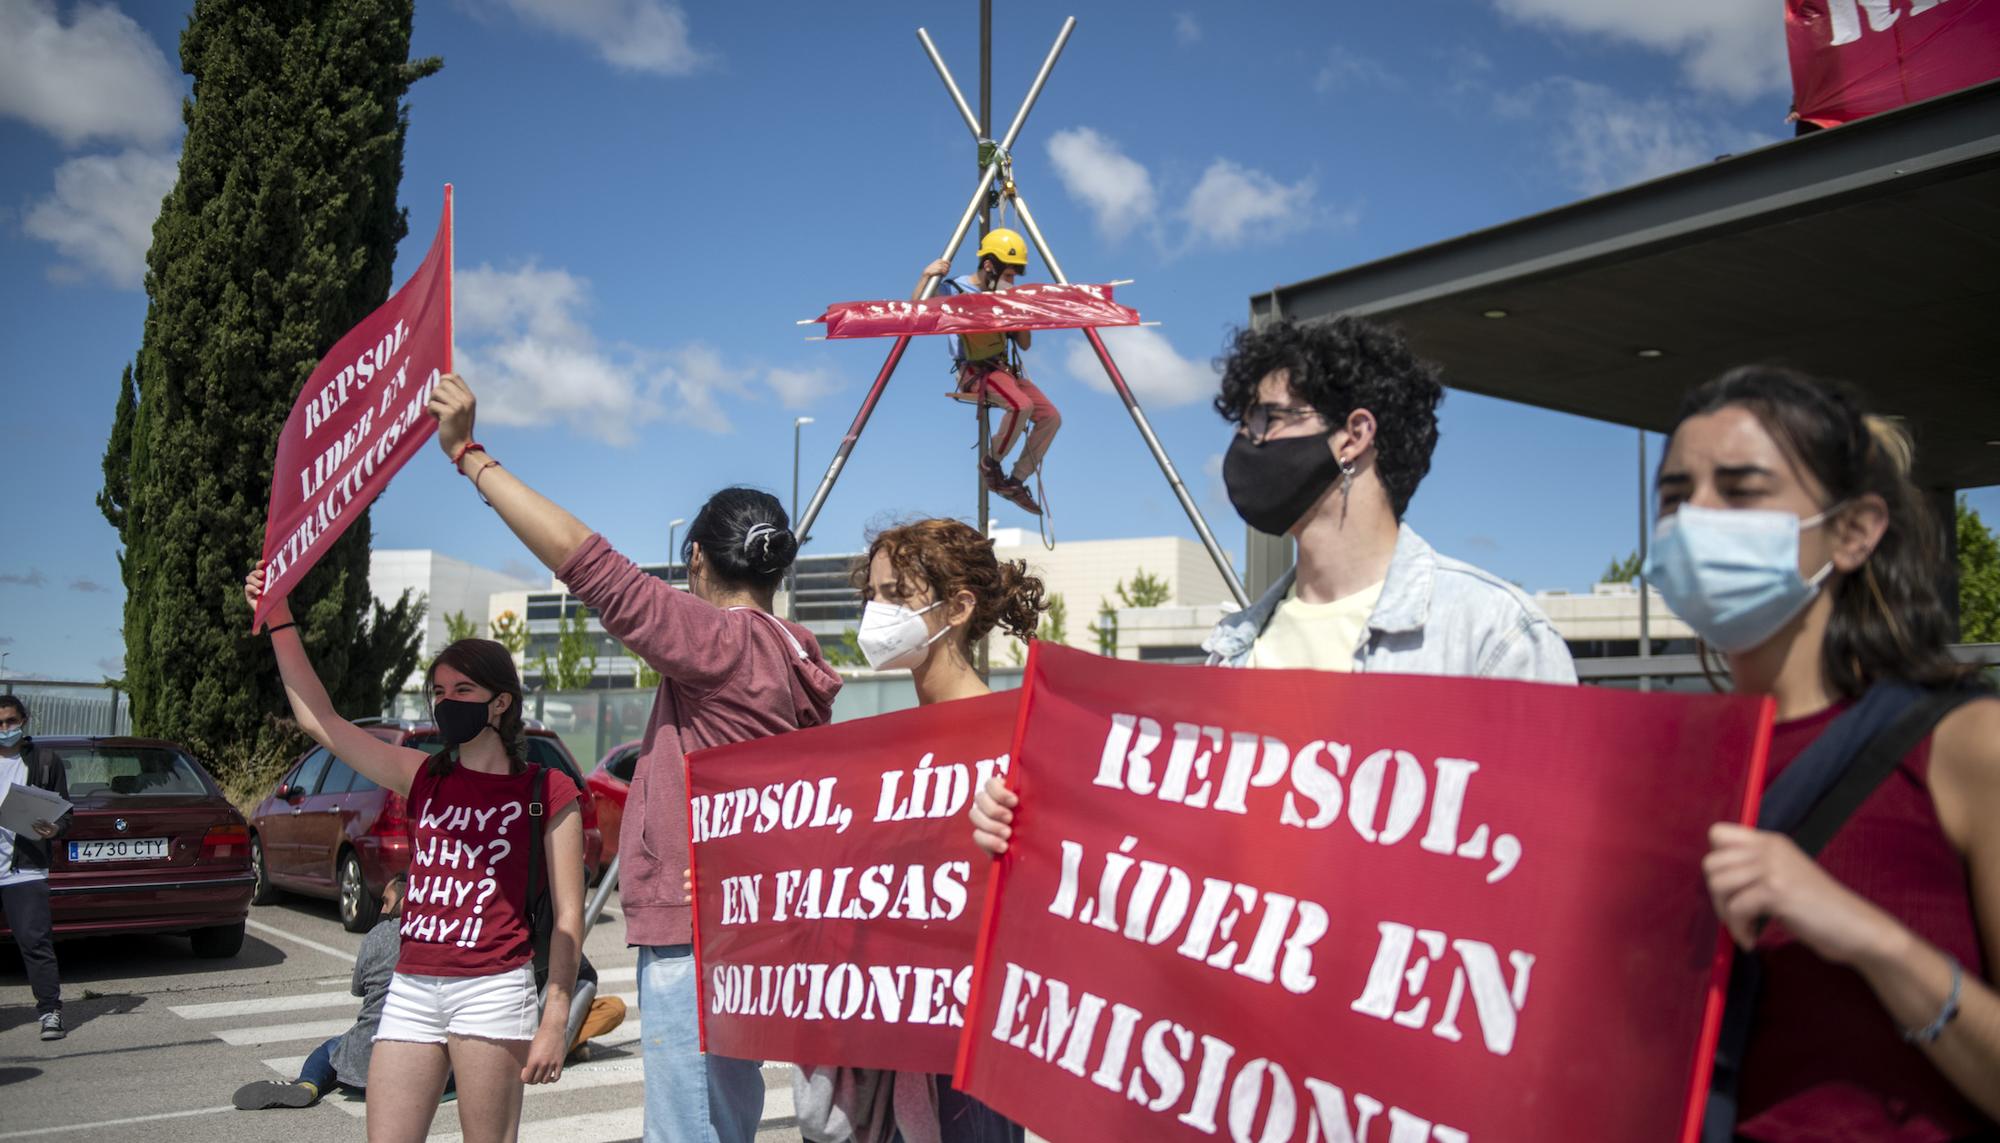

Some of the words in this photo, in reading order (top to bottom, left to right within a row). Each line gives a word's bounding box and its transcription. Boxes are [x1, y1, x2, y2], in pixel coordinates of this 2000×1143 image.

[305, 318, 409, 439] REPSOL
[379, 355, 410, 418] EN
[262, 367, 440, 596] EXTRACTIVISMO
[419, 798, 523, 835] WHY?
[690, 777, 853, 843] REPSOL,
[1093, 713, 1523, 884] REPSOL,
[82, 841, 127, 858] 4730
[134, 839, 163, 855] CTY
[415, 836, 512, 876] WHY?
[407, 874, 497, 915] WHY?
[721, 873, 762, 925] EN
[772, 861, 970, 921] FALSAS
[400, 911, 483, 948] WHY!!
[1048, 835, 1330, 994] LÍDER
[1350, 920, 1536, 1056] EN
[712, 962, 974, 1028] SOLUCIONES
